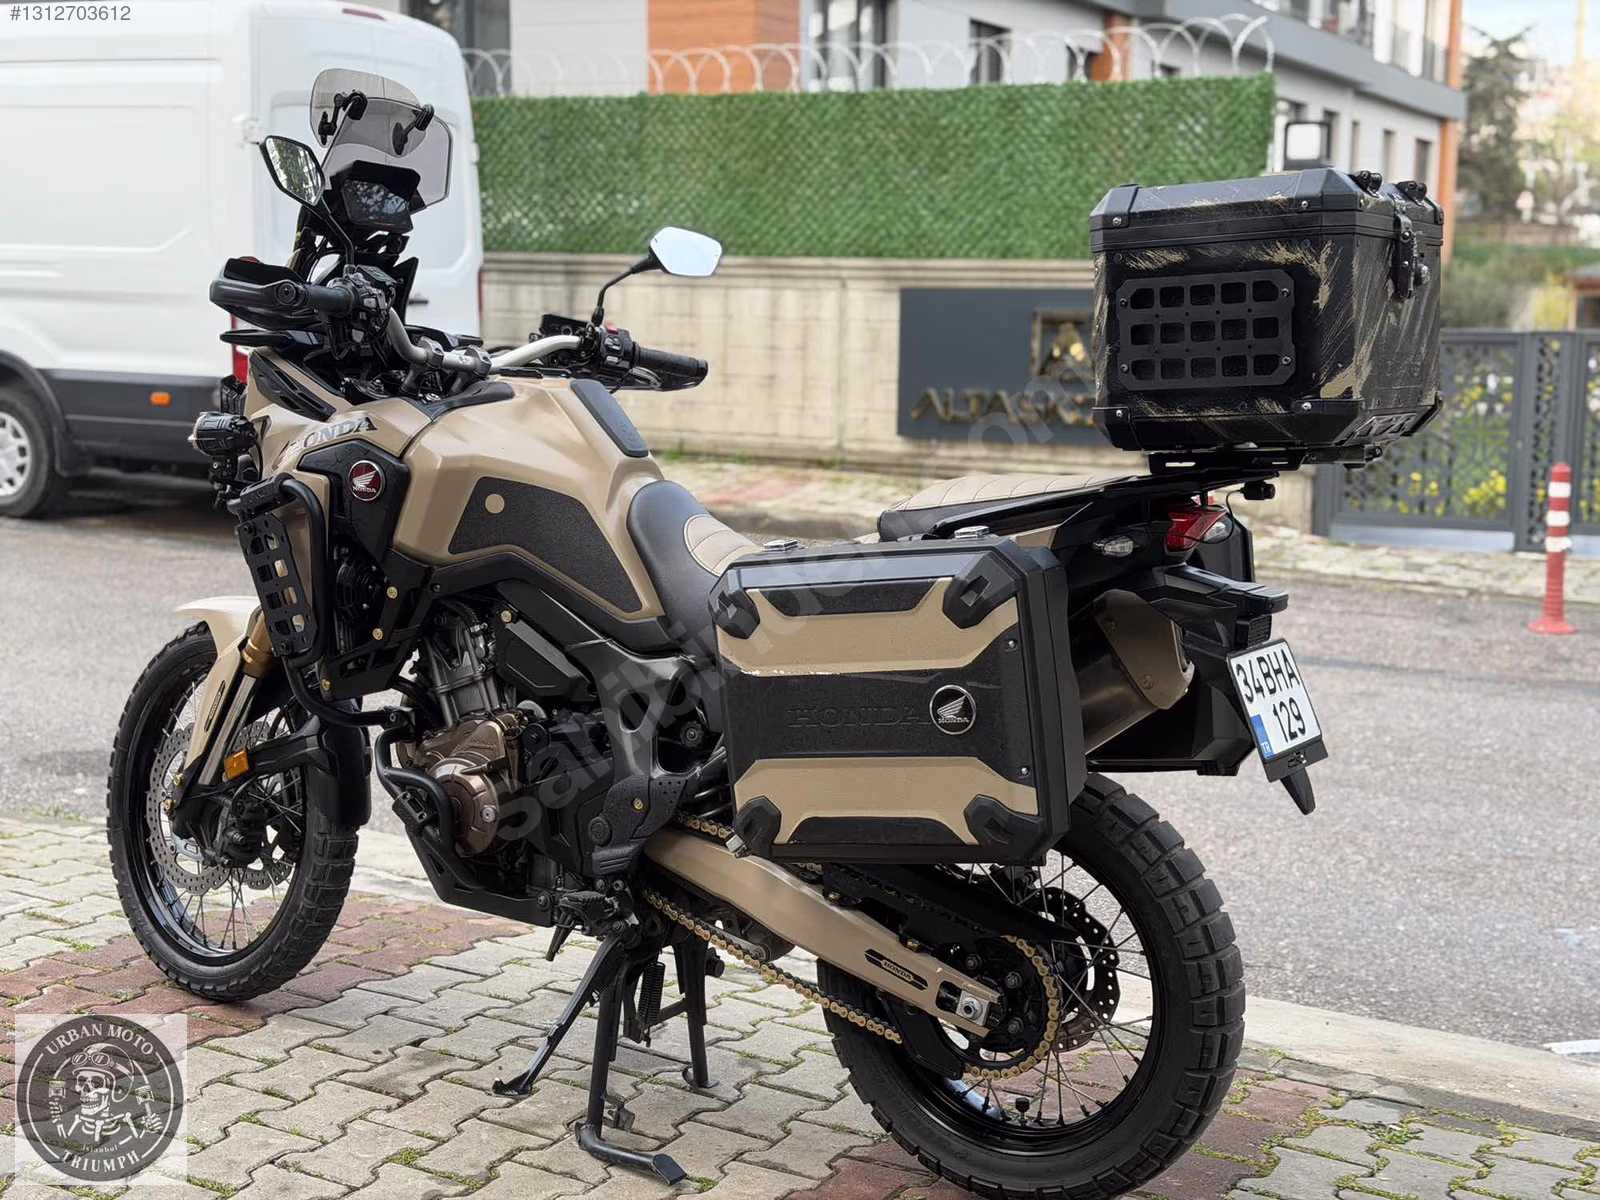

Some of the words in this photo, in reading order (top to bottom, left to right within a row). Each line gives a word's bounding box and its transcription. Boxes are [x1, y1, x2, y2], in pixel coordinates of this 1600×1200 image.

[352, 485, 377, 493] HONDA
[1235, 649, 1300, 703] 34BHA
[1272, 697, 1306, 743] 129
[883, 961, 912, 980] HONDA
